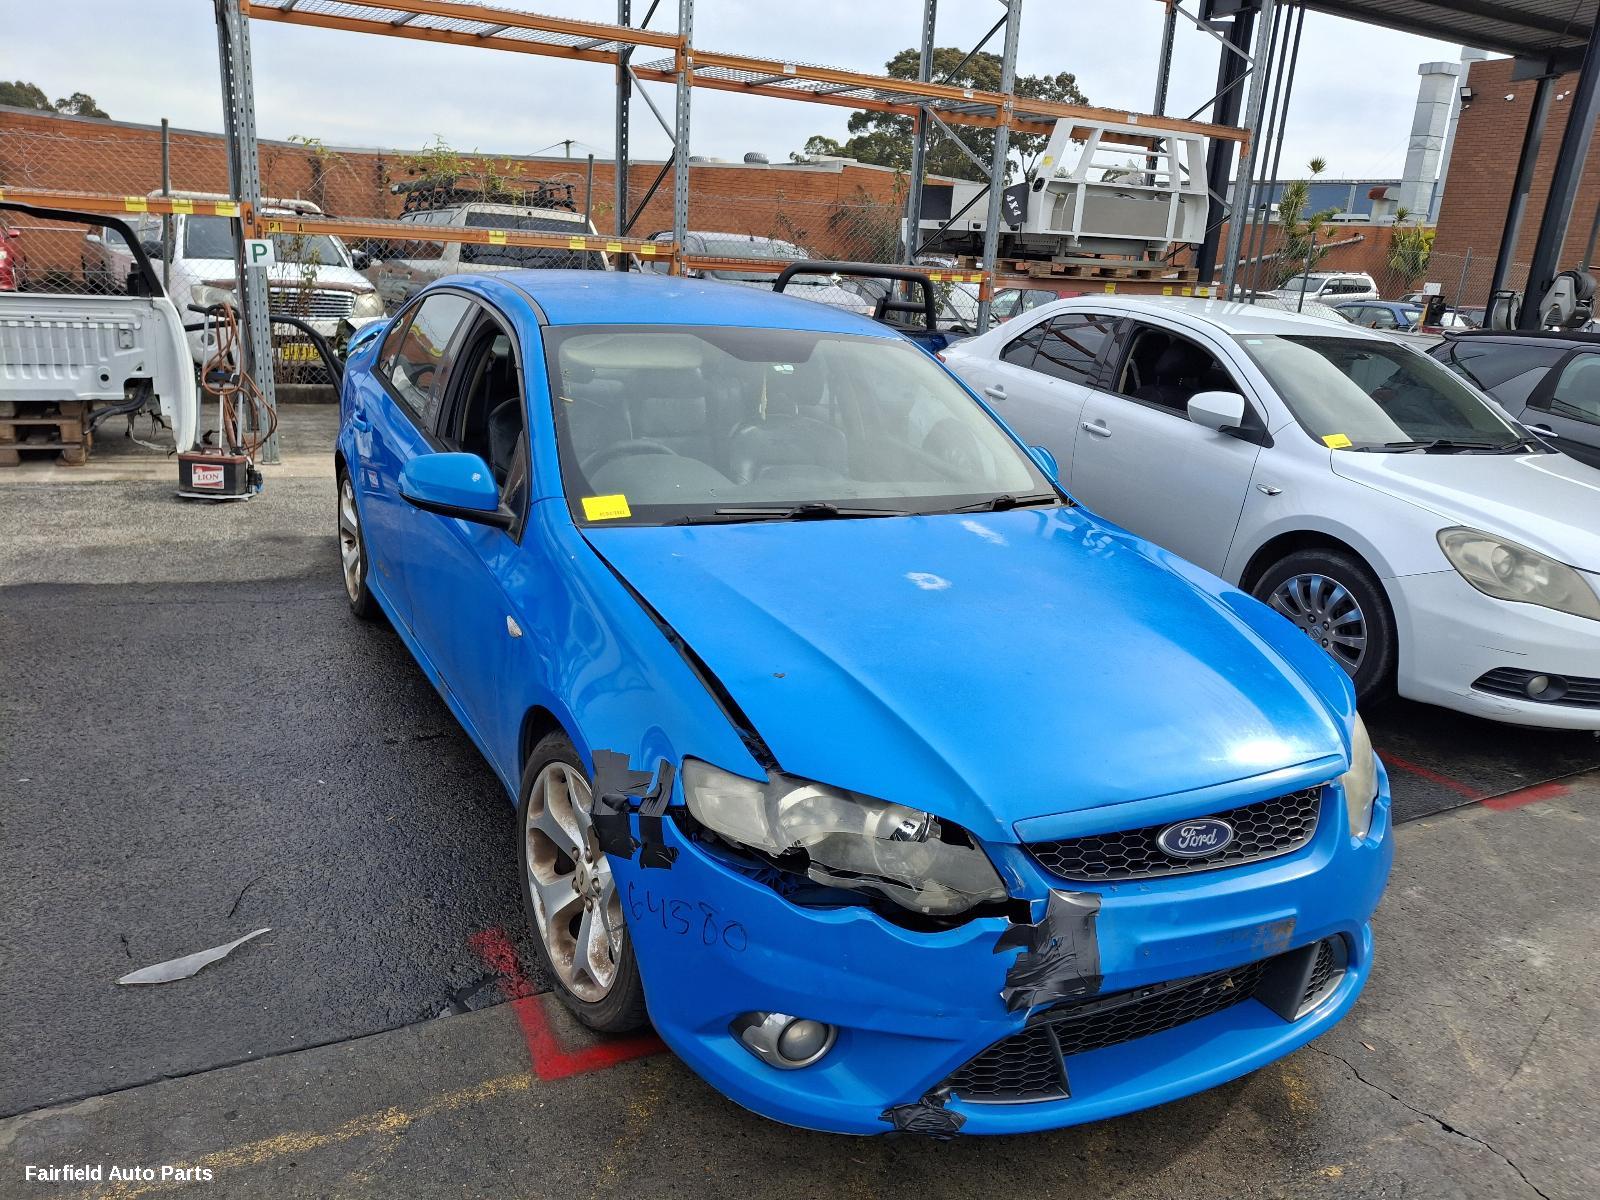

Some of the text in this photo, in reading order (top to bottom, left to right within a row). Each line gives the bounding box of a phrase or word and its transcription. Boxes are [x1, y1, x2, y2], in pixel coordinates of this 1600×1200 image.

[251, 243, 268, 263] P
[197, 473, 219, 481] LION
[1178, 824, 1218, 849] Ford
